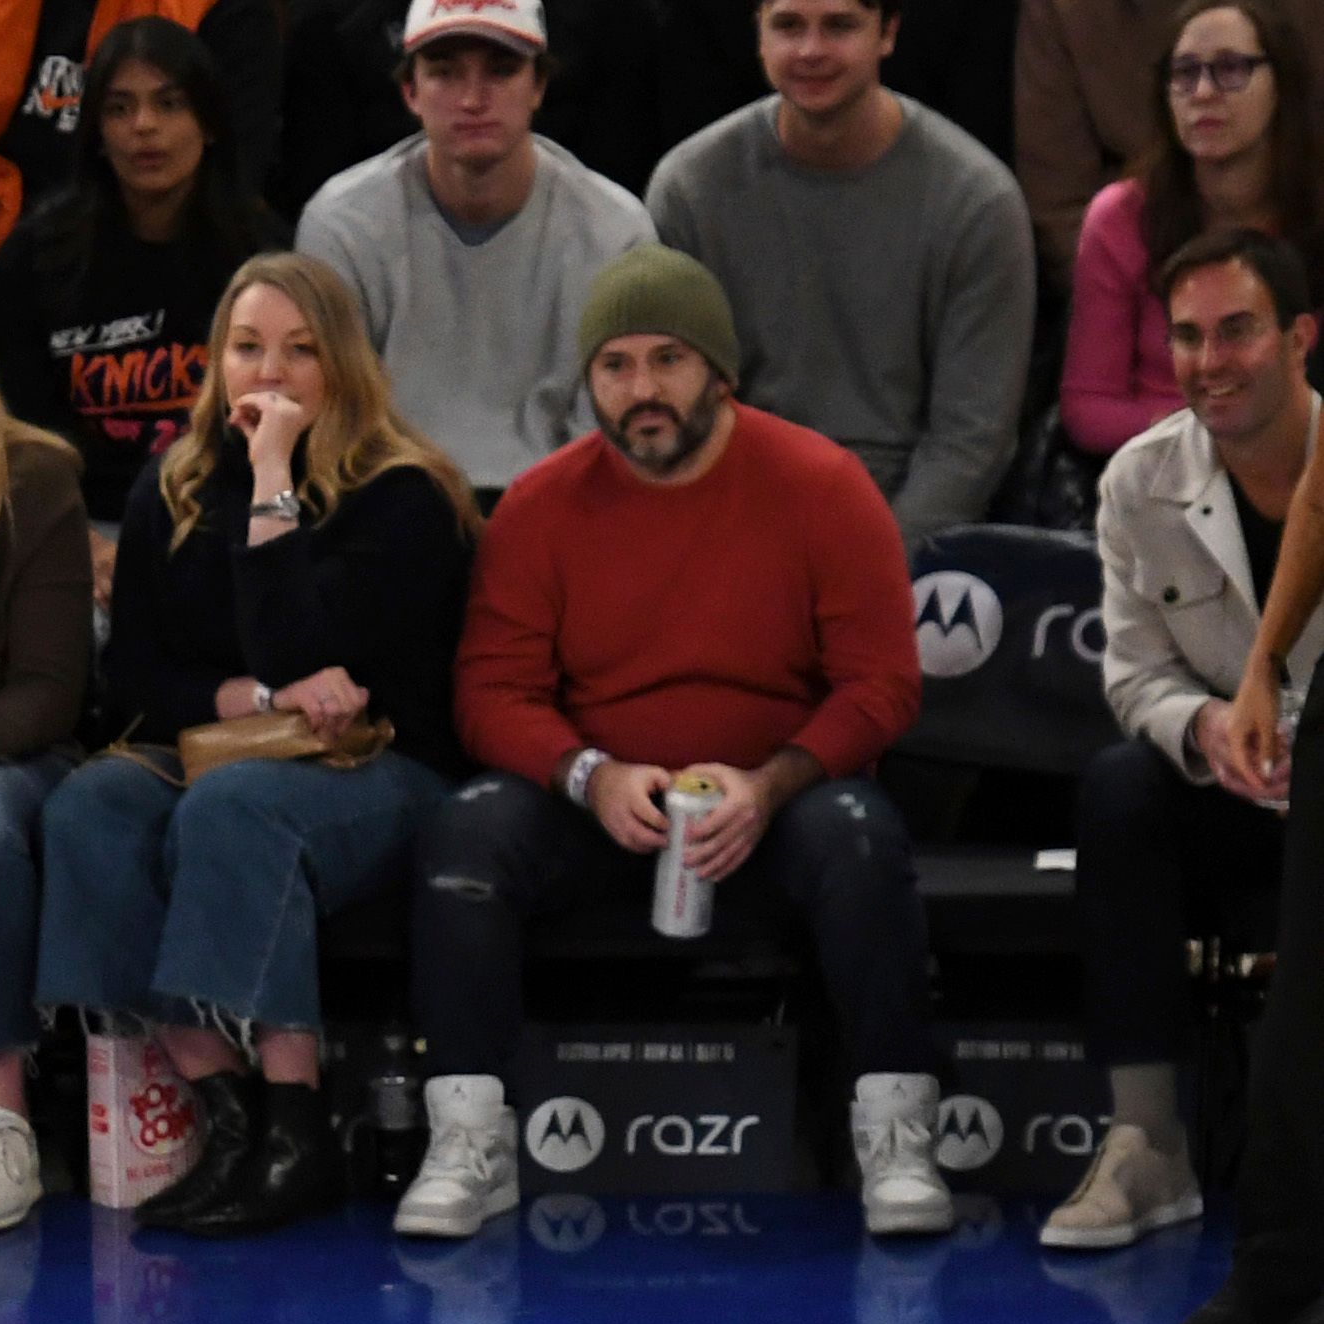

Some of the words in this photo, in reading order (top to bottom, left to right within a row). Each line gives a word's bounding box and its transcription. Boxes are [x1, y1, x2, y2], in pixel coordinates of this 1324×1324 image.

[1034, 603, 1104, 661] ra
[626, 1115, 760, 1153] razr
[1025, 1114, 1110, 1155] ra
